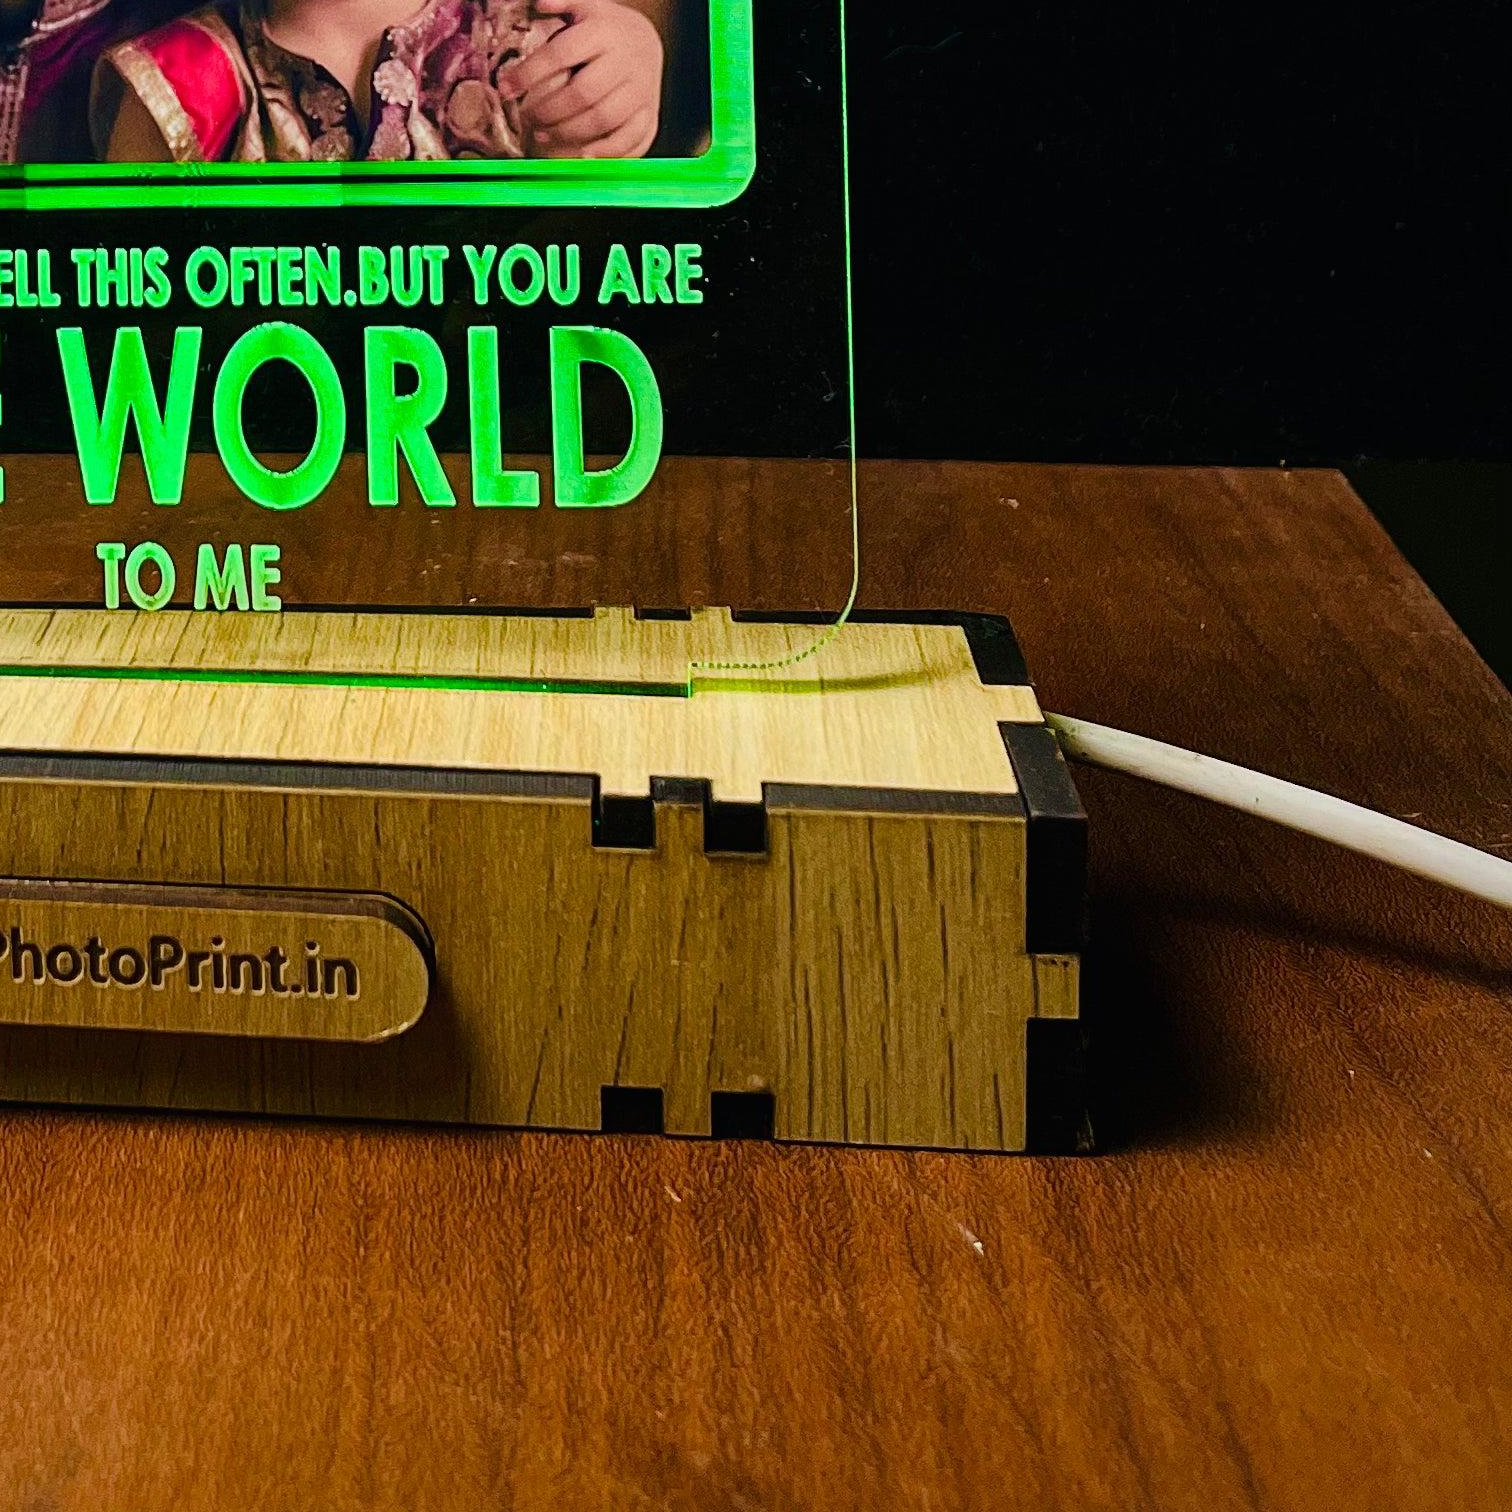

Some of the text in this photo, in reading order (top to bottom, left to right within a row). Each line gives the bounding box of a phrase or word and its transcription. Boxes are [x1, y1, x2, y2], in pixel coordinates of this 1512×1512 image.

[70, 248, 170, 307] THIS
[462, 244, 581, 306] YOU
[598, 243, 704, 304] ARE
[56, 321, 664, 510] WORLD
[96, 542, 283, 612] TO ME
